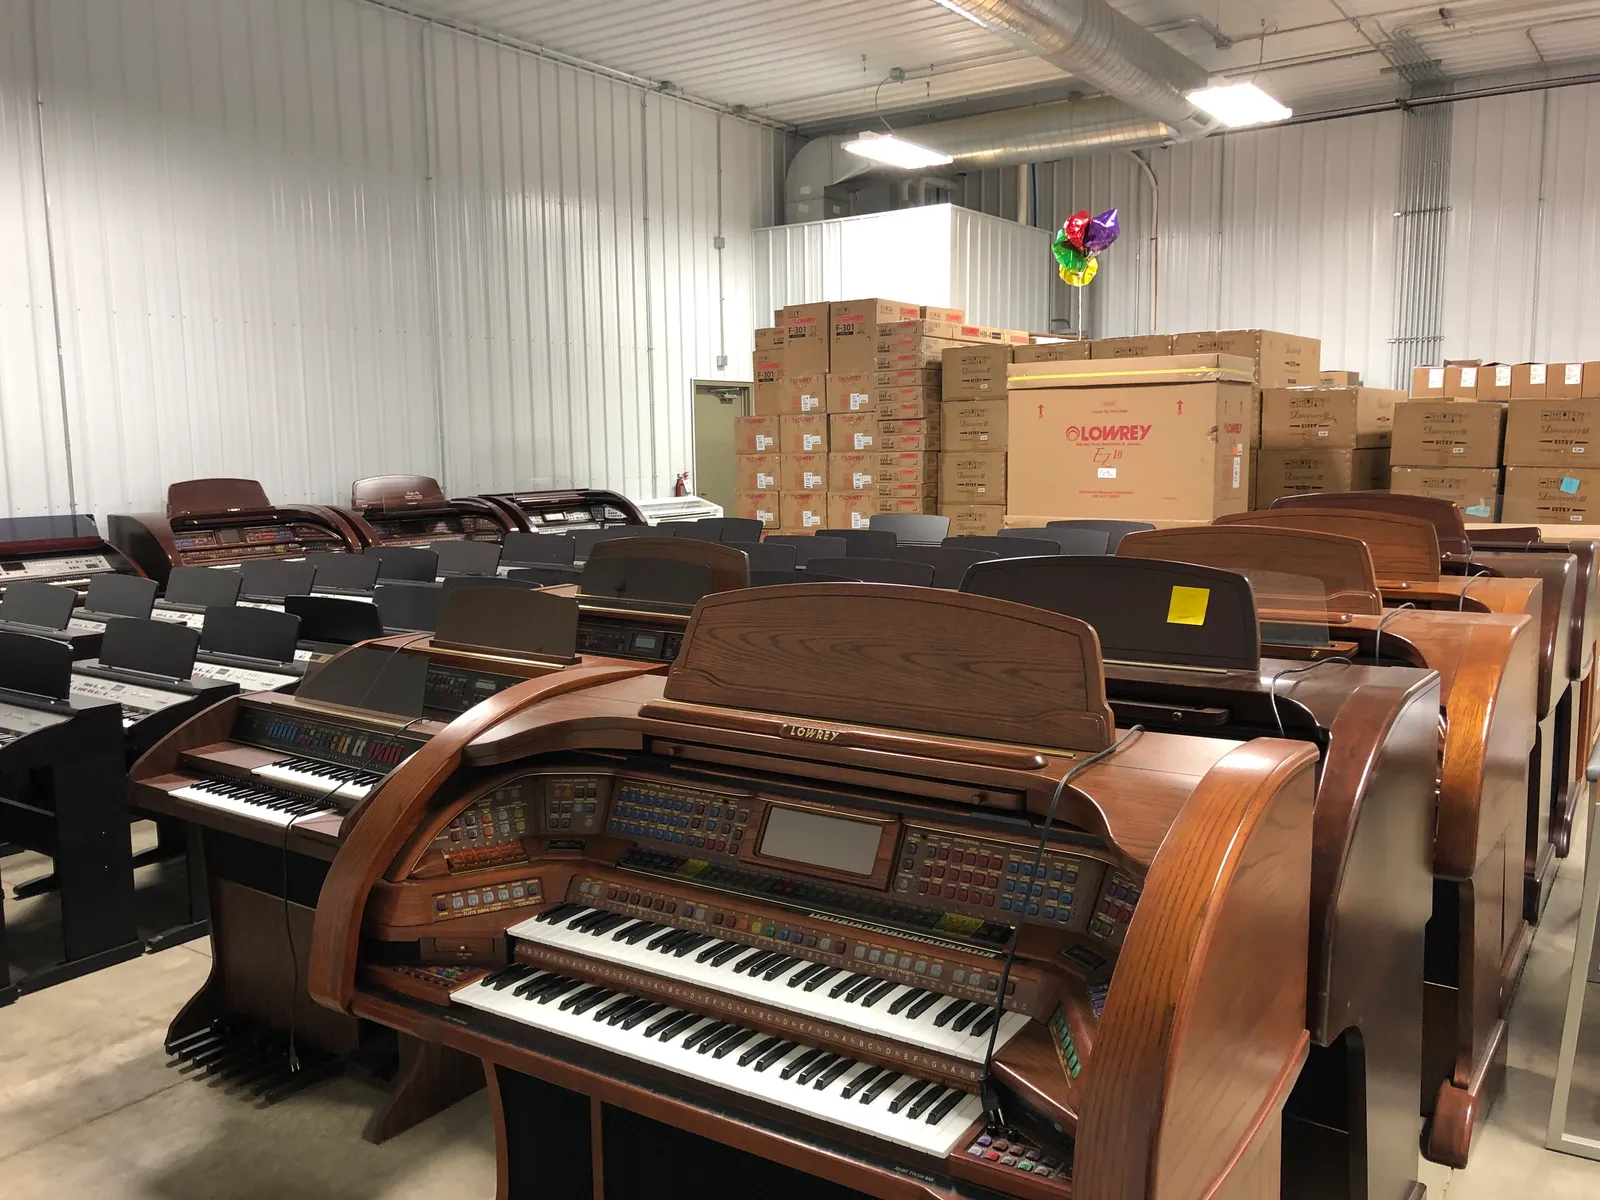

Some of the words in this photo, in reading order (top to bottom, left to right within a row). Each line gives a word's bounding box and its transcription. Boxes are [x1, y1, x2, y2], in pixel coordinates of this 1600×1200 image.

[980, 330, 992, 338] HM-4
[1081, 424, 1152, 441] LOWREY
[790, 726, 840, 741] LOWREY
